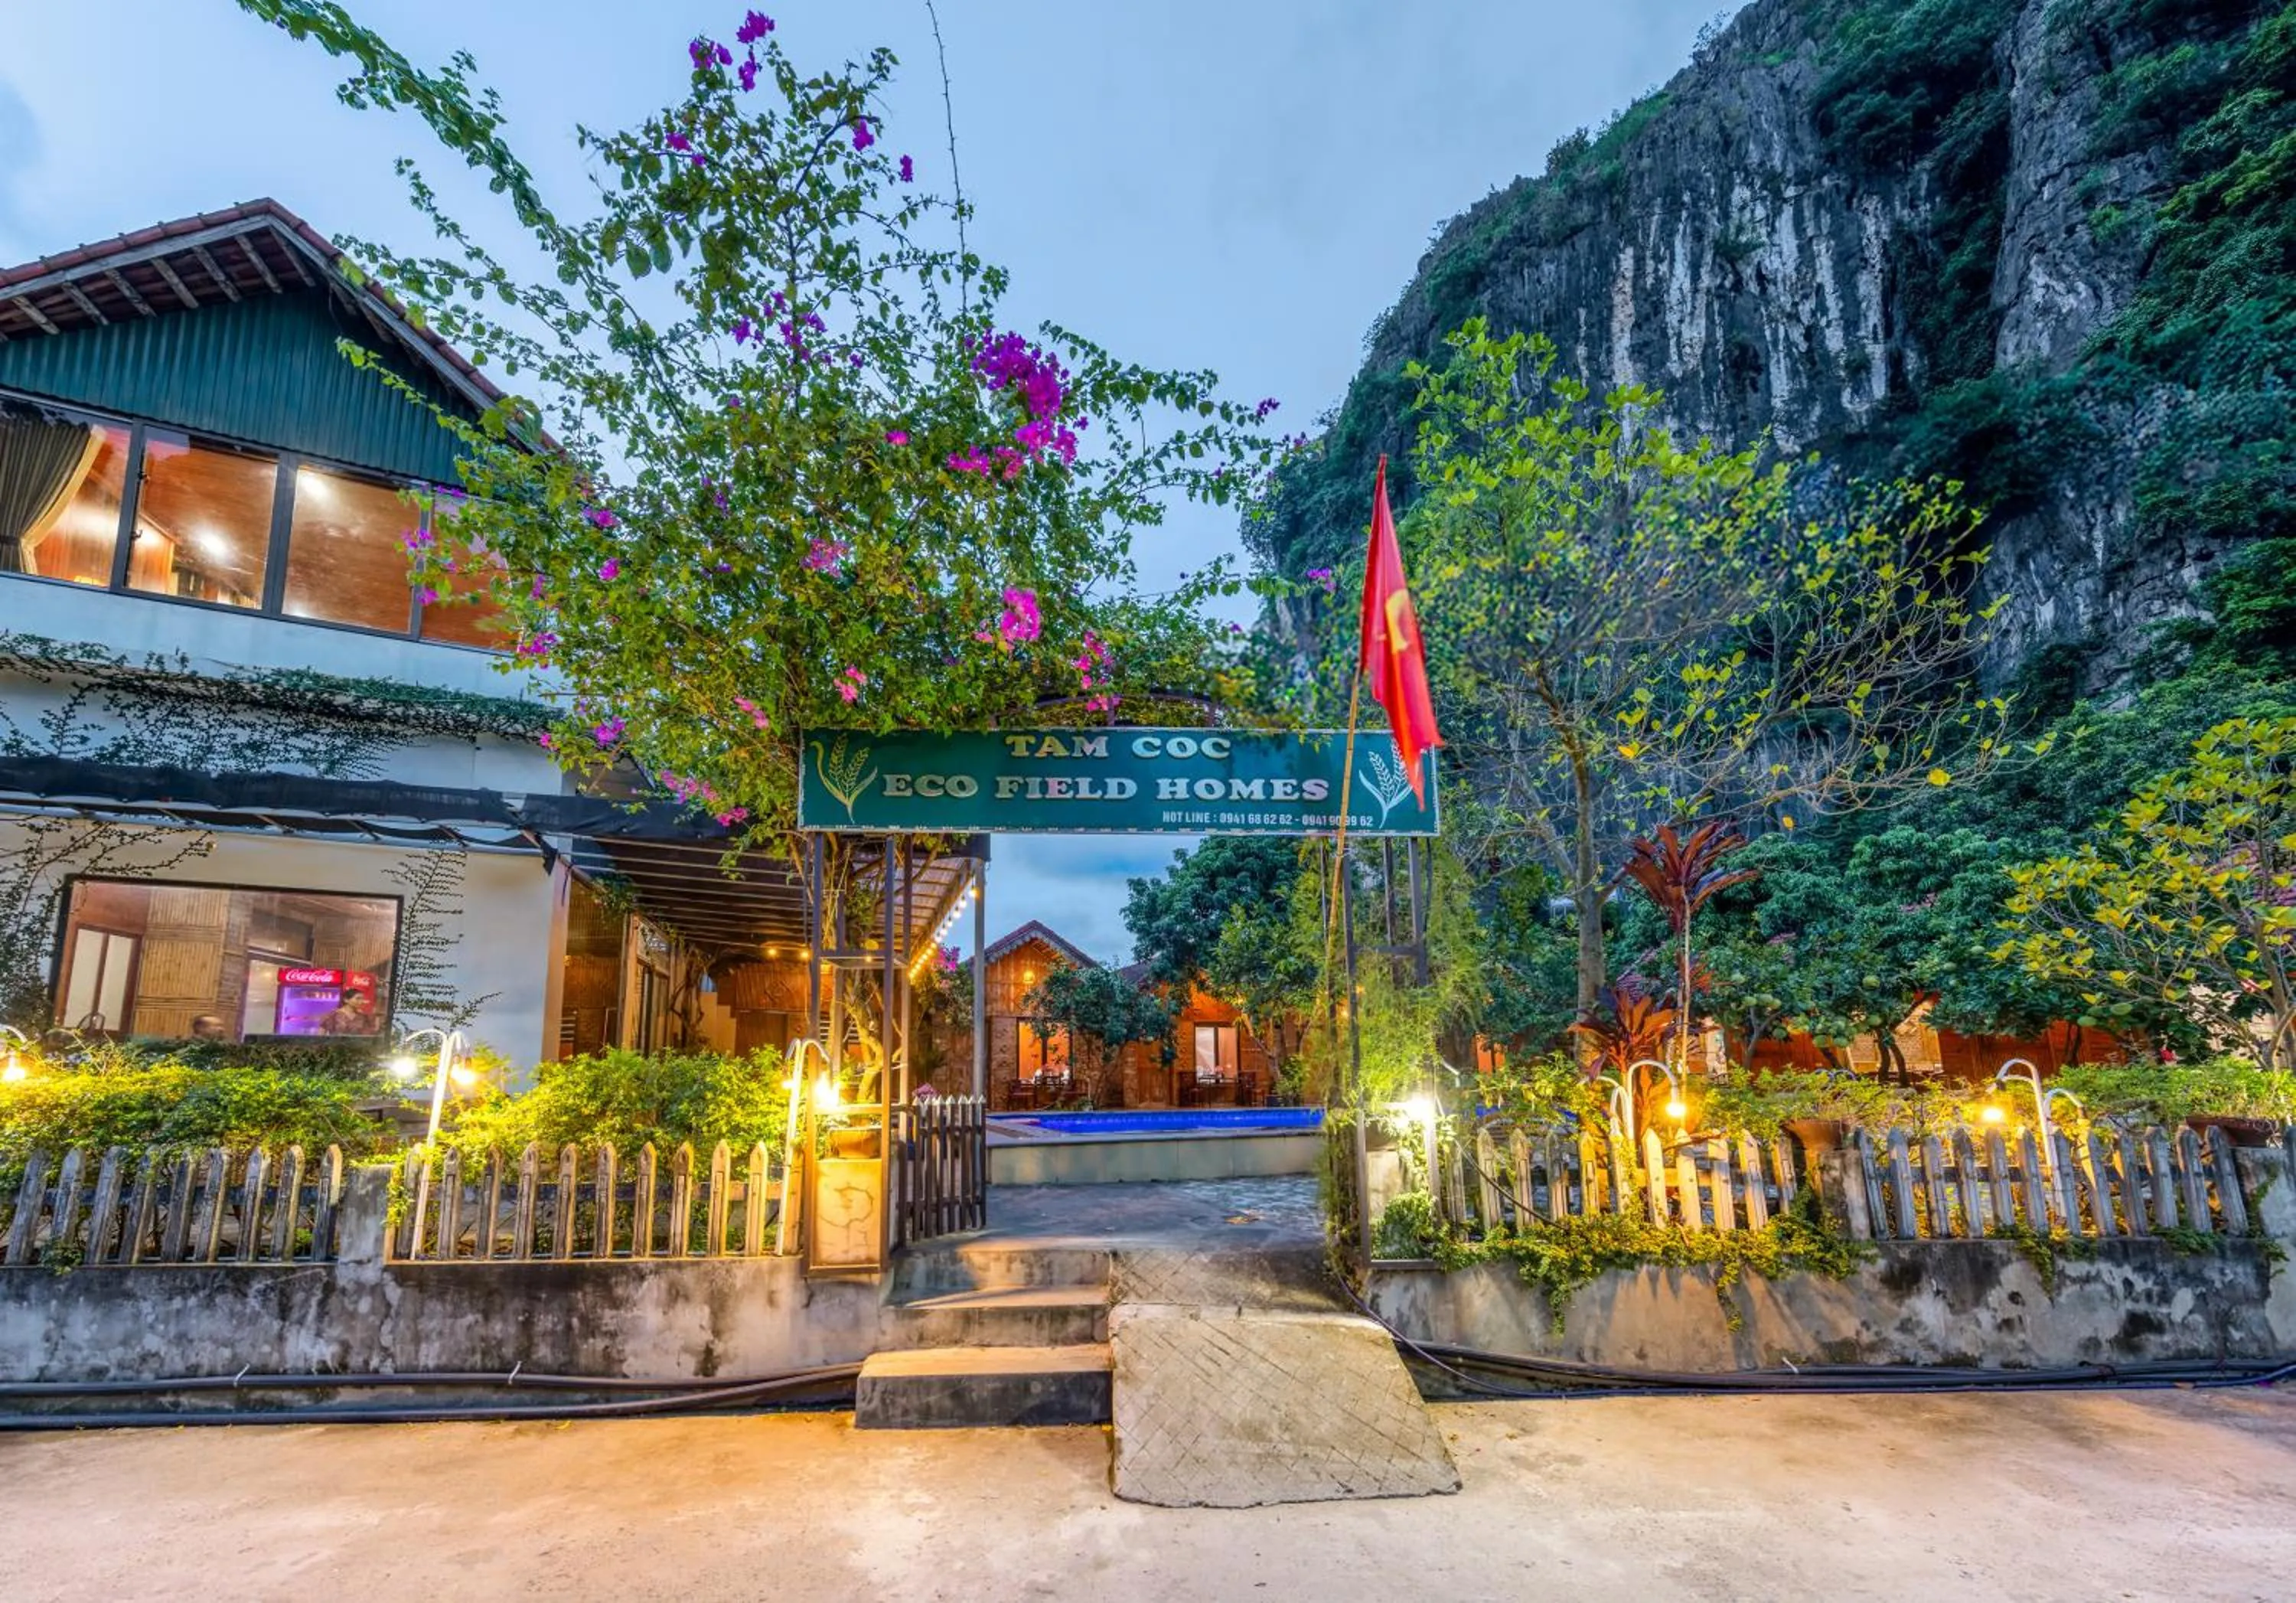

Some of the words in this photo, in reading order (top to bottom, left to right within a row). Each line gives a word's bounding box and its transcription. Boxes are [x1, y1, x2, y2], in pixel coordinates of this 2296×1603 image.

[1005, 735, 1108, 758] TAM
[1132, 736, 1231, 759] COC
[882, 774, 979, 798] ECO
[994, 775, 1137, 800] FIELD
[1156, 778, 1329, 802] HOMES
[1163, 811, 1182, 823] HOT
[1185, 811, 1211, 824] LINE
[1263, 813, 1278, 825] 62
[1359, 815, 1374, 828] 62
